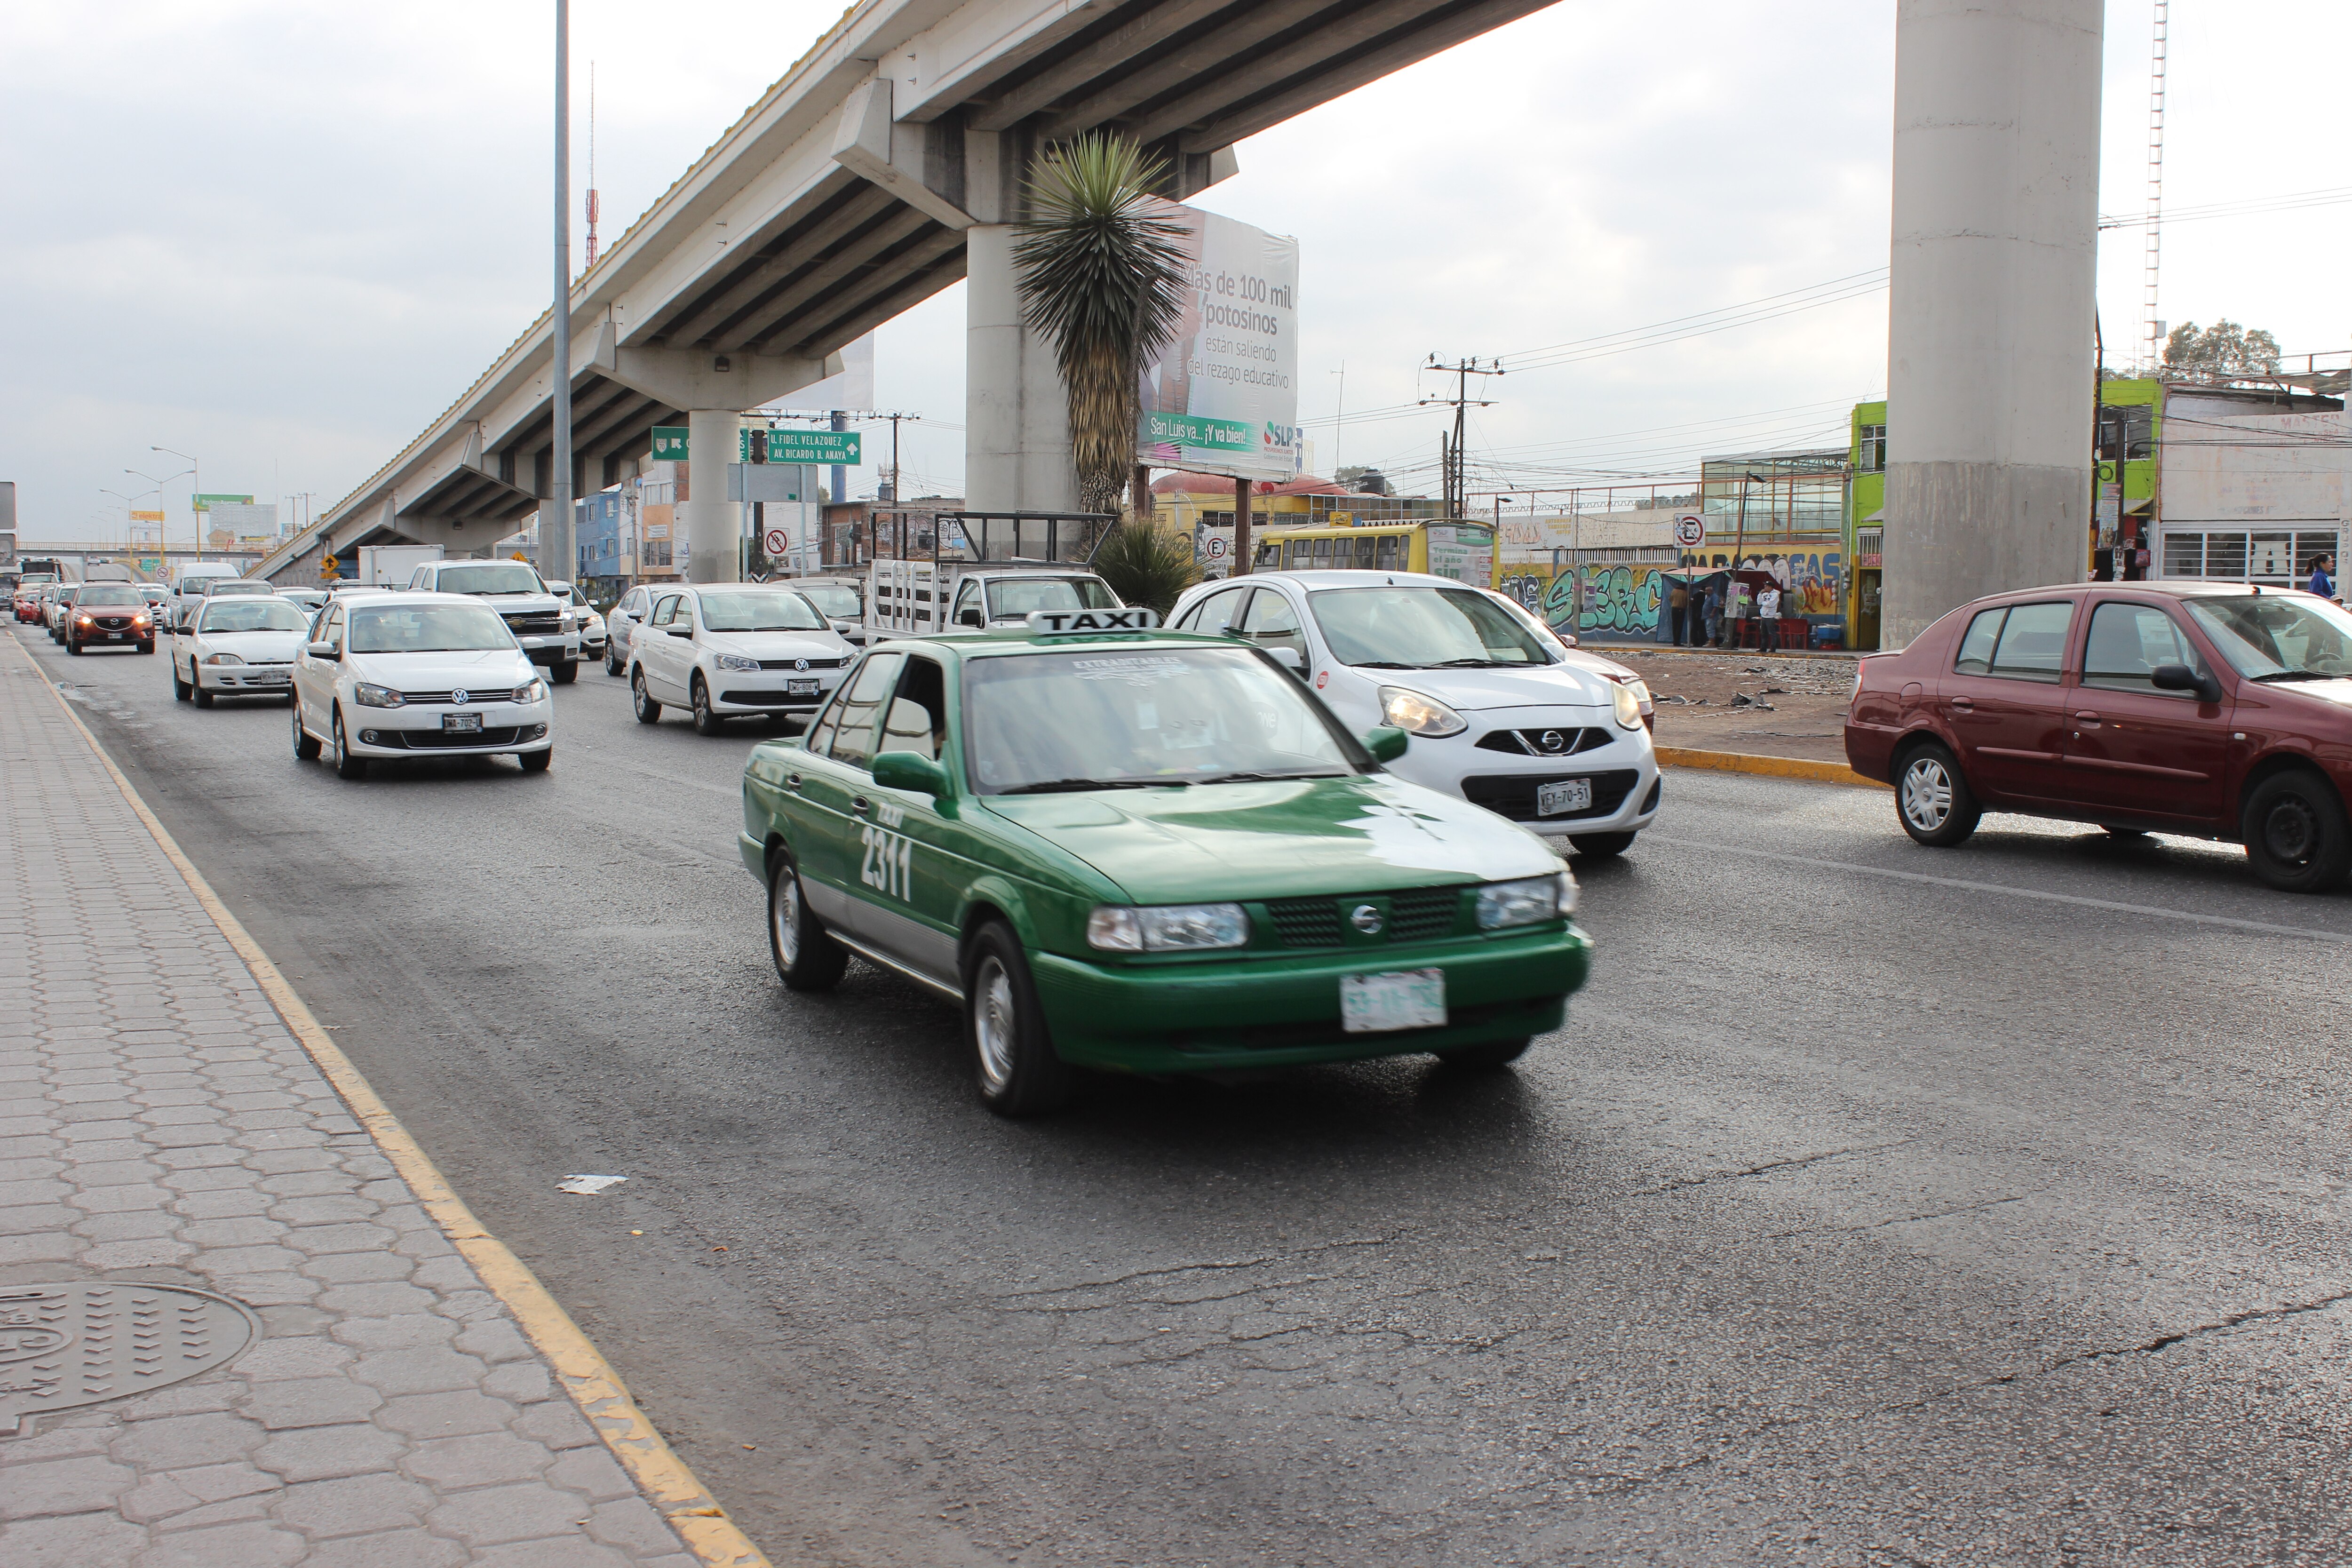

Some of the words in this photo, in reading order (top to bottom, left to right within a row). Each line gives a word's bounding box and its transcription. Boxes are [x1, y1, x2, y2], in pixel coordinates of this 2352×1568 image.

[1216, 270, 1235, 297] de
[1240, 274, 1266, 303] 100
[1271, 284, 1292, 310] mil
[1206, 302, 1277, 335] potosinos
[1206, 334, 1233, 355] están
[1236, 339, 1276, 362] saliendo
[1188, 356, 1204, 376] del
[1207, 362, 1240, 385] rezago
[1243, 366, 1289, 389] educativo
[771, 434, 777, 444] U.
[779, 434, 799, 445] FIDEL
[801, 435, 842, 446] VELAZQUEZ
[1150, 417, 1167, 436] San
[1168, 419, 1185, 438] Luis
[1187, 426, 1203, 440] va...
[1204, 424, 1214, 445] ¡Y
[1215, 429, 1225, 442] va
[1226, 425, 1246, 445] bien!
[1274, 425, 1294, 447] SLP
[774, 448, 784, 459] AV.
[786, 449, 815, 459] RICARDO
[817, 450, 824, 460] B.
[826, 450, 847, 461] ANAYA
[1212, 541, 1221, 554] E
[1434, 564, 1460, 579] sin
[1042, 612, 1147, 630] TAXI
[861, 825, 913, 902] 2311
